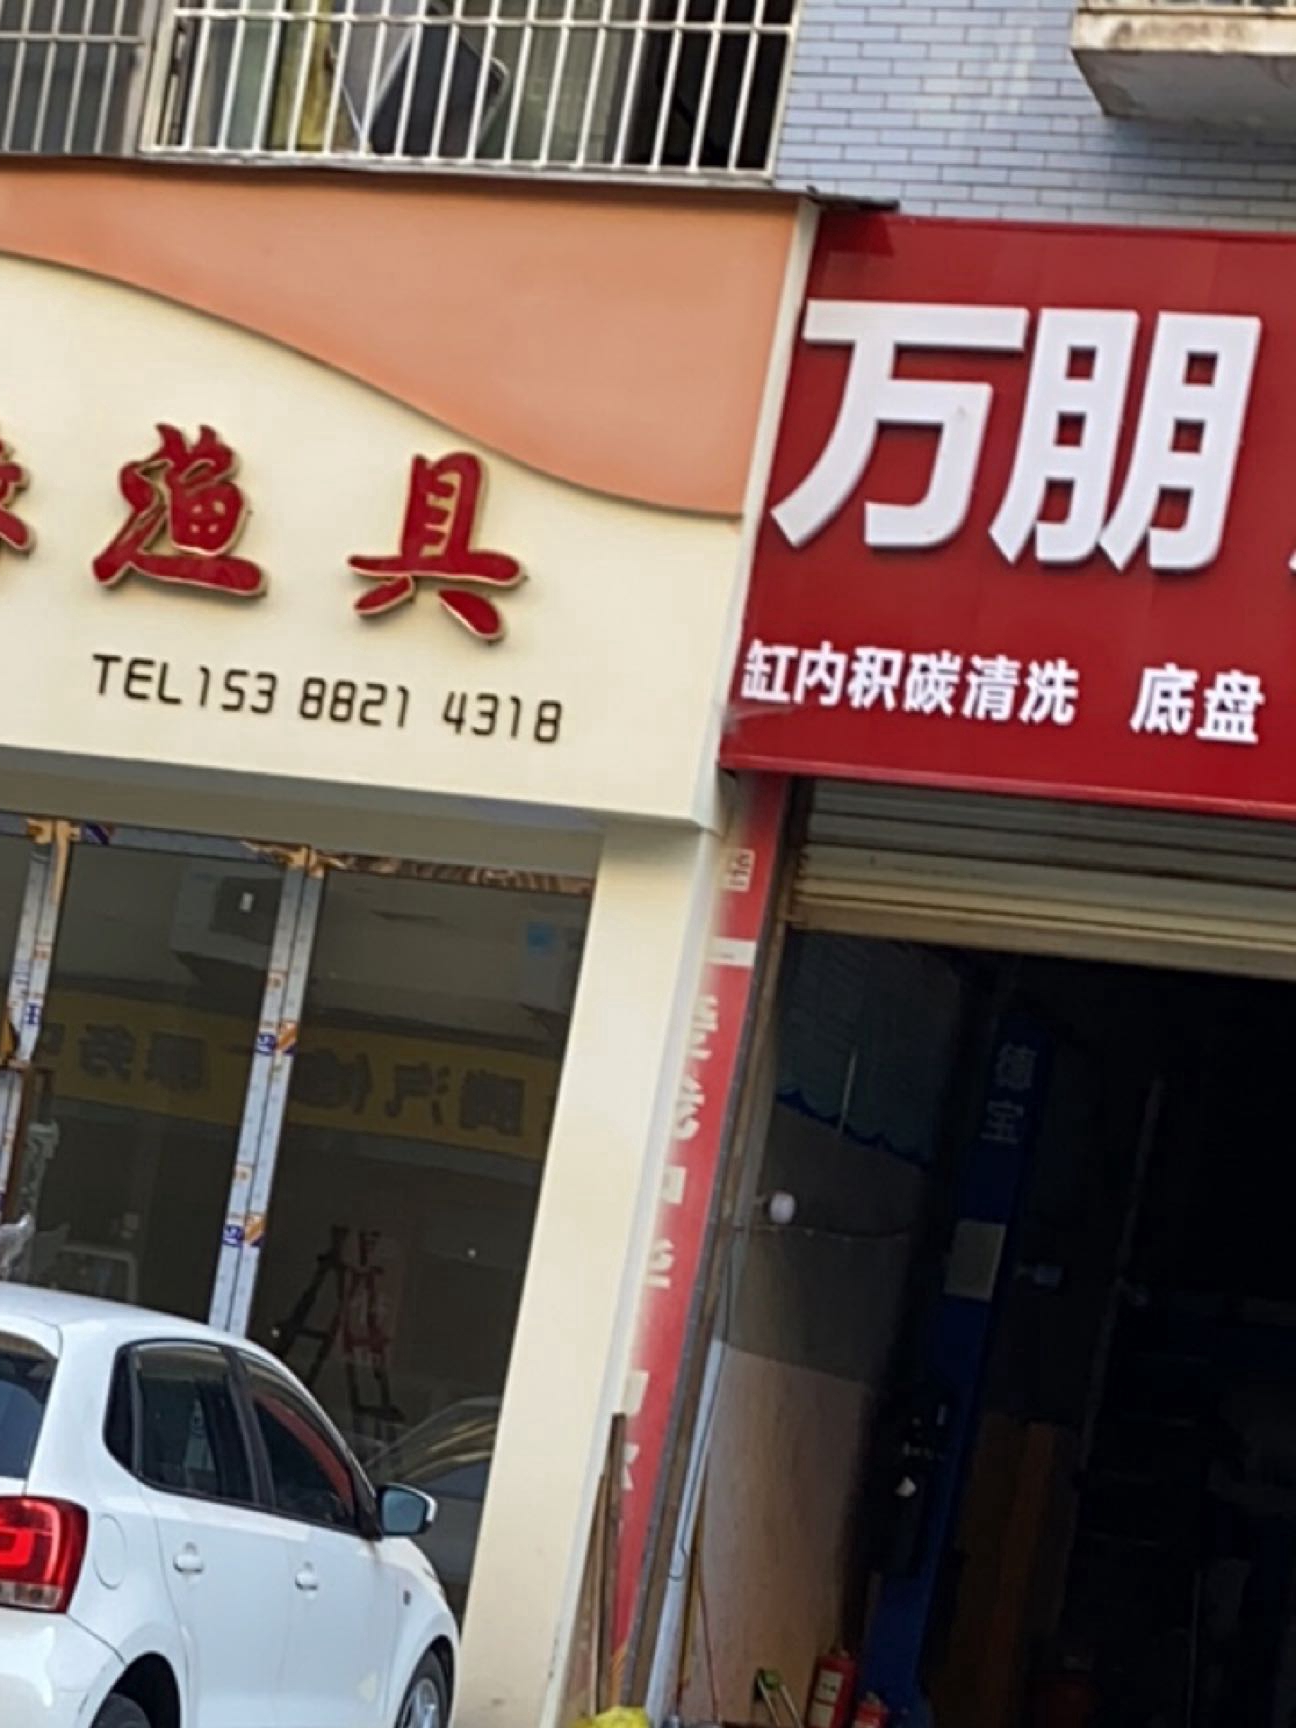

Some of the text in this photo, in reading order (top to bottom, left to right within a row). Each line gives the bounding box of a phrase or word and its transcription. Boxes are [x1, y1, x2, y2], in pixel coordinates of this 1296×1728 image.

[770, 299, 1296, 573] 万朋
[299, 676, 410, 728] 8821
[442, 690, 563, 744] 4318
[740, 637, 1265, 744] 缸内积碳清洗 底盘
